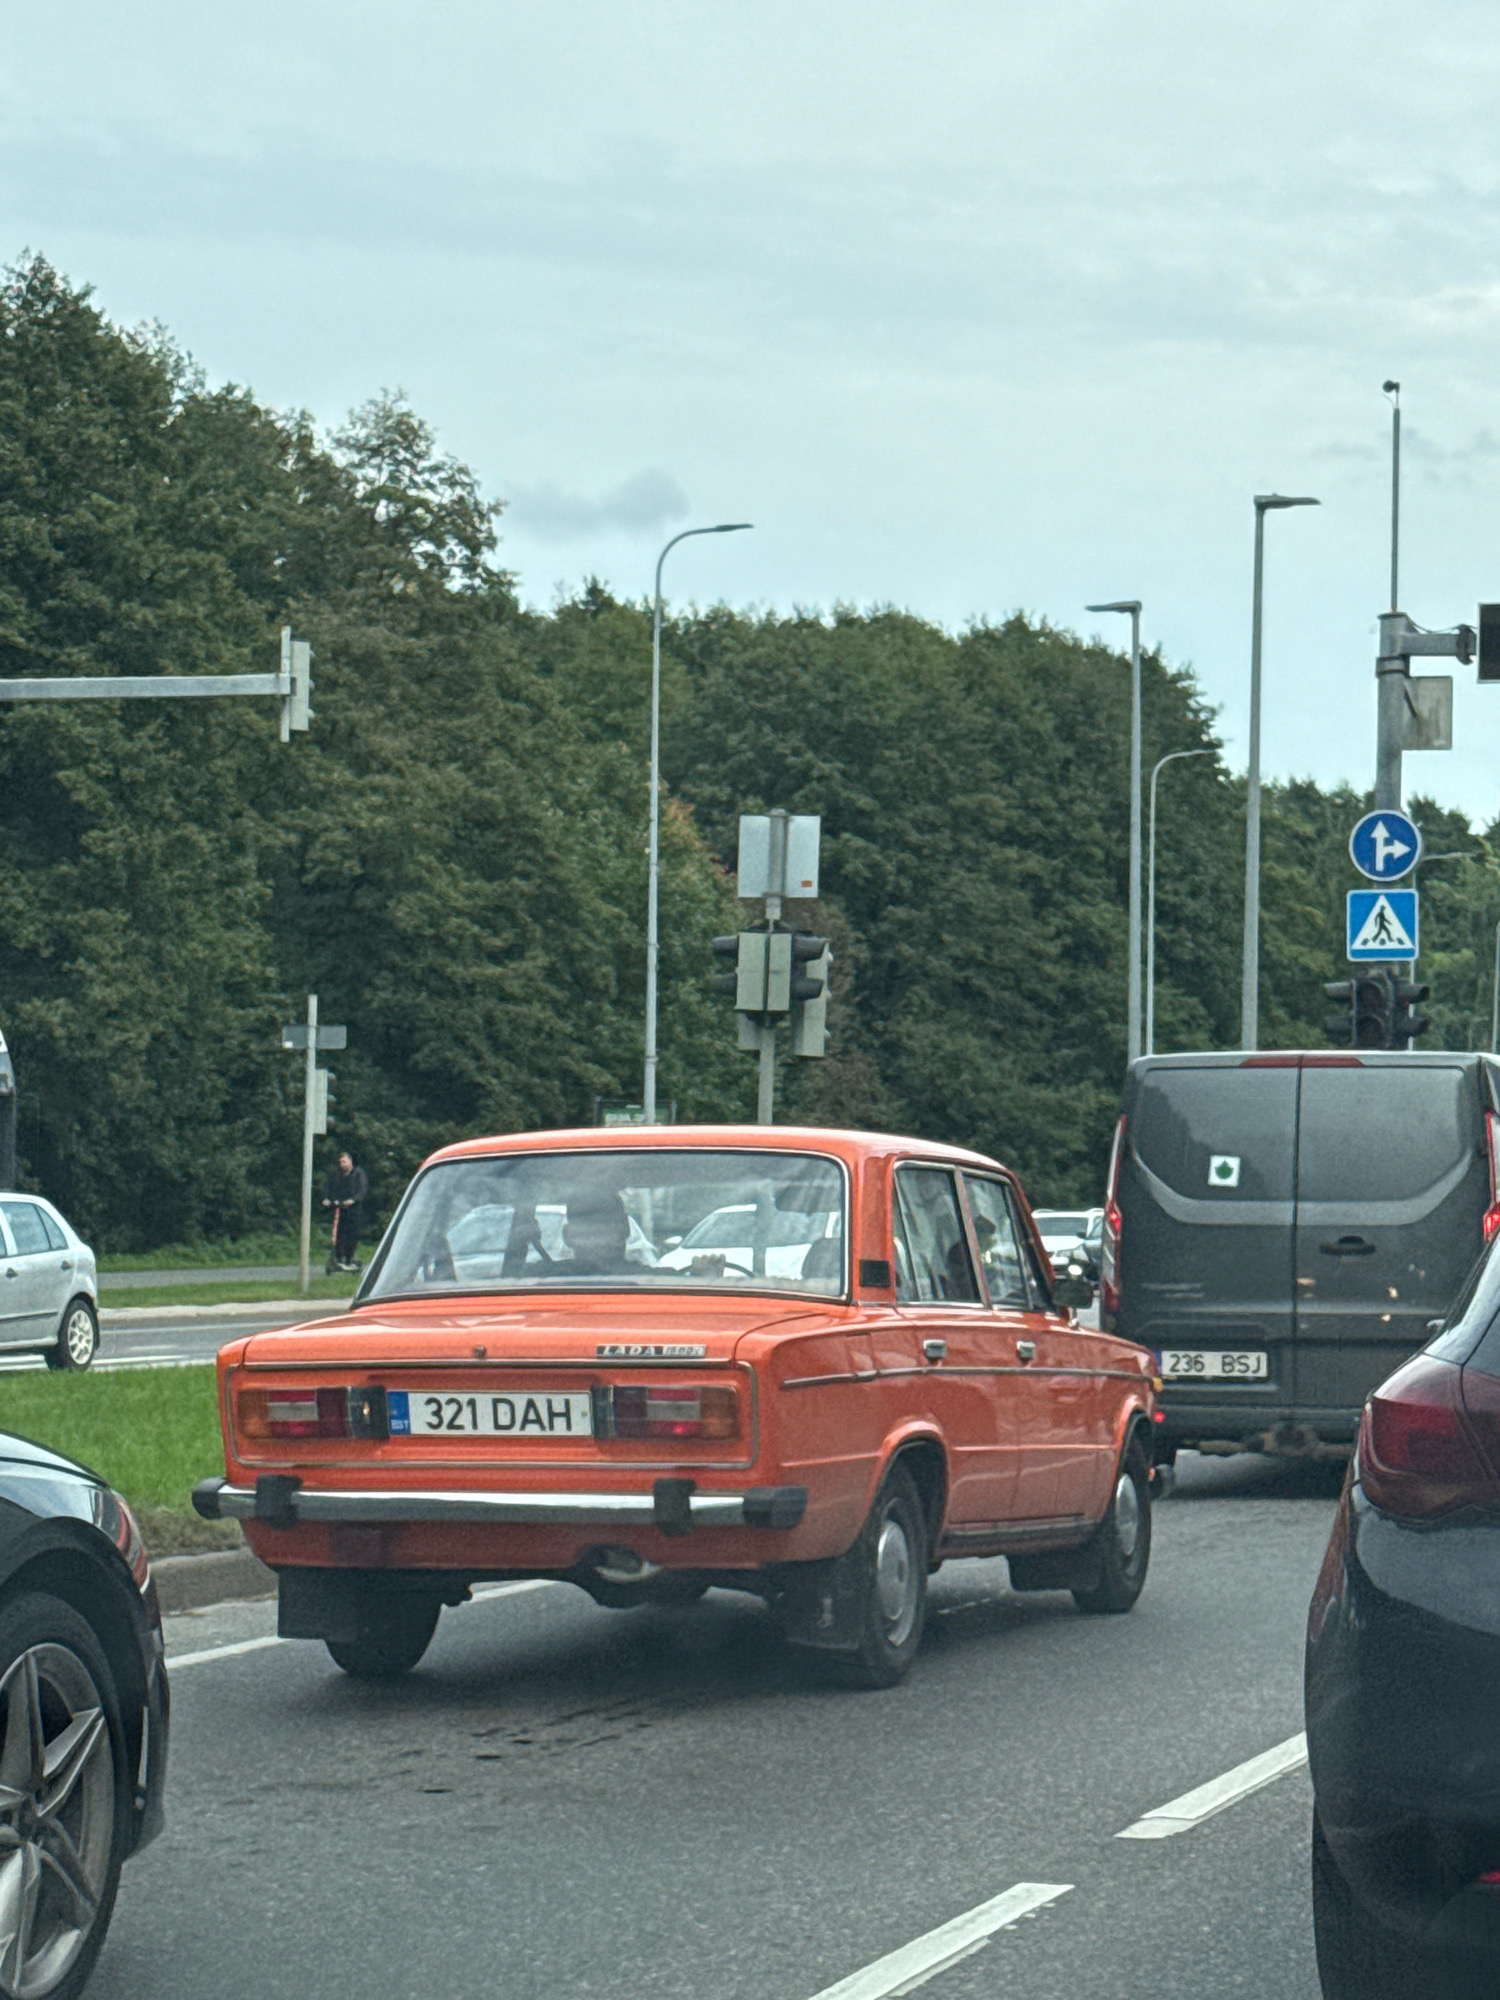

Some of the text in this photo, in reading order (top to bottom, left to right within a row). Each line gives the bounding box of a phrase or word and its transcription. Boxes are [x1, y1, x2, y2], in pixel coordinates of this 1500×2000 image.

[603, 1345, 655, 1356] LADA
[1169, 1353, 1261, 1374] 236 BSJ
[424, 1397, 572, 1432] 321 DAH
